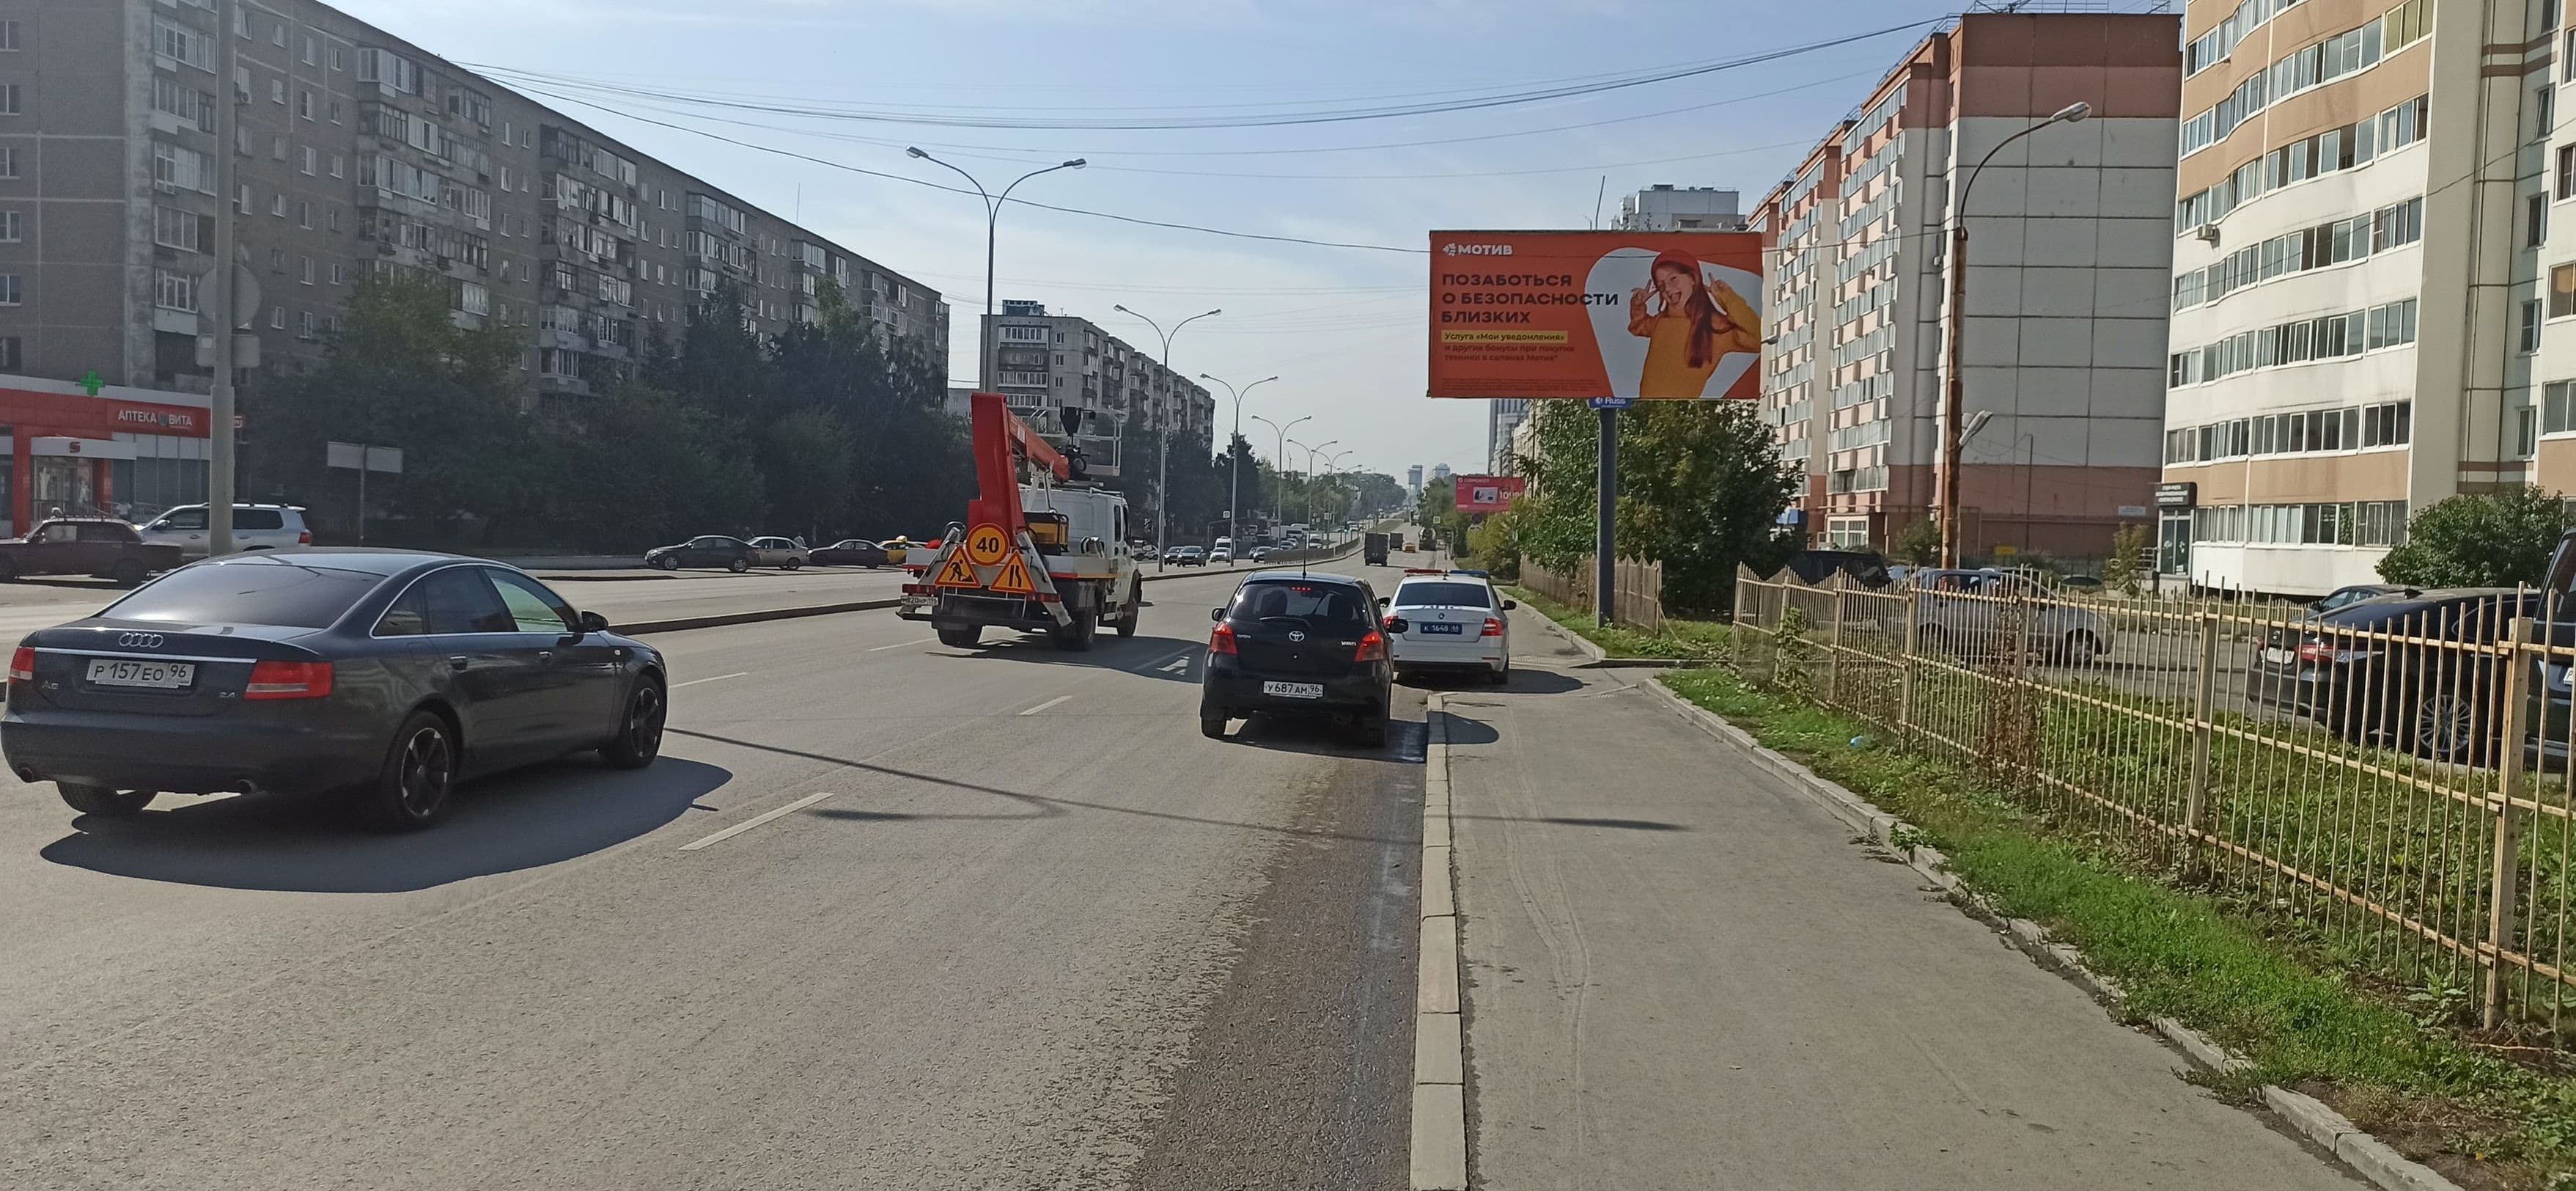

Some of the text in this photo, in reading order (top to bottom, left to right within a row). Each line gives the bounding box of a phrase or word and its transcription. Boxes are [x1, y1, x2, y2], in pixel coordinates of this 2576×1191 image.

[1457, 245, 1513, 255] МОТИВ
[1442, 274, 1572, 287] ПОЗАБОТЬСЯ
[1442, 293, 1619, 306] О БЕЗОПАСНОСТИ
[1441, 311, 1531, 323] БЛИЗКИХ
[1444, 333, 1474, 341] Услуга
[1501, 334, 1565, 342] уведомления»
[1485, 343, 1518, 353] бонусы
[1605, 397, 1626, 405] Russ
[118, 410, 193, 427] АПТЕКА ВИТА
[976, 536, 1000, 554] 40
[169, 664, 187, 678] 96
[1309, 685, 1320, 693] 96
